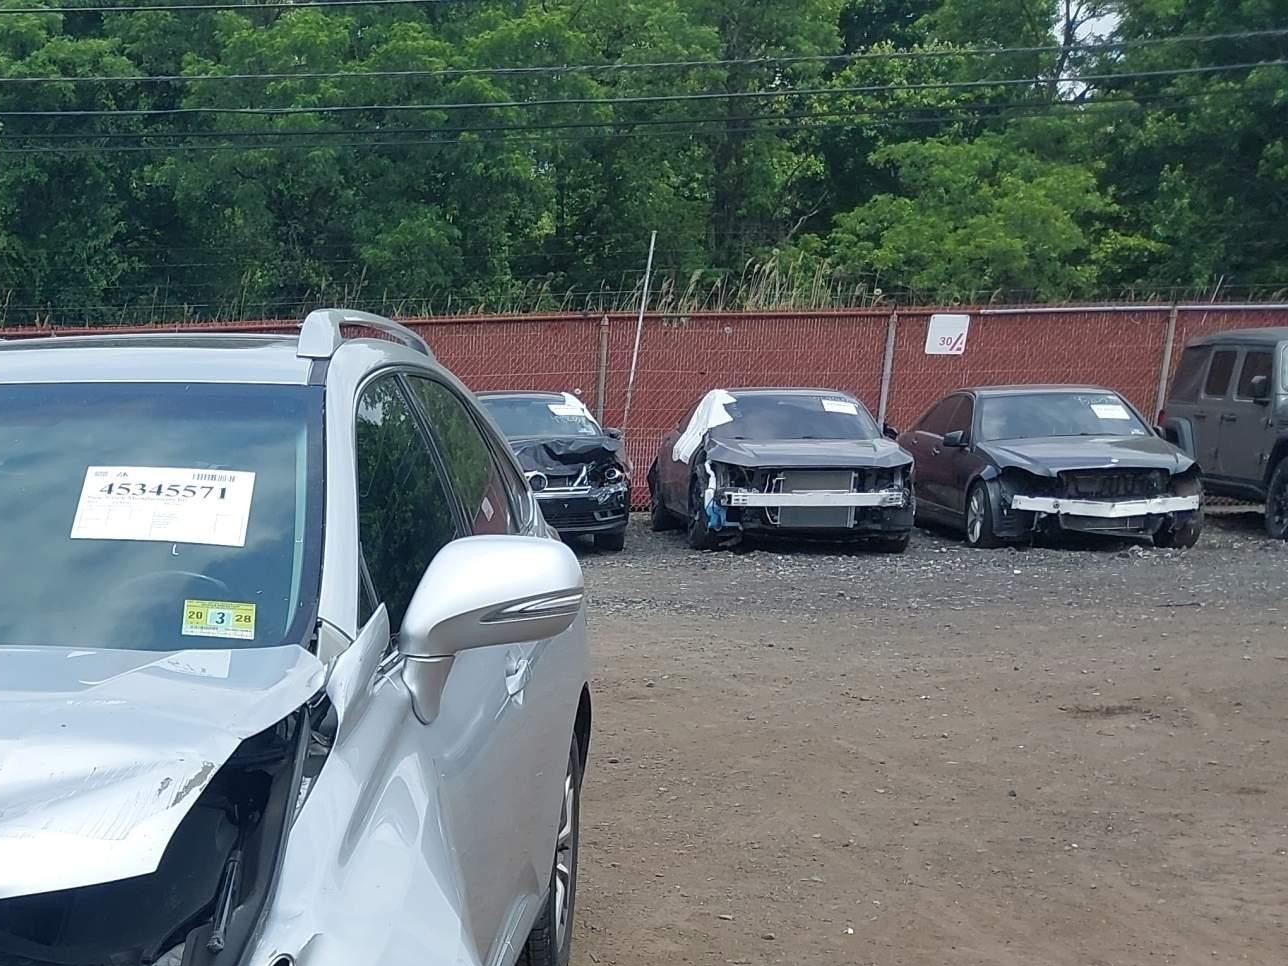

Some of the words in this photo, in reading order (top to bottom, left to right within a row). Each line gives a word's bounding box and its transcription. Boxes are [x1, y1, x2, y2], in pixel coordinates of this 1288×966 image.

[939, 336, 952, 346] 30
[99, 482, 228, 500] 45345571
[188, 611, 203, 620] 20
[216, 612, 225, 625] 3
[235, 614, 251, 623] 28
